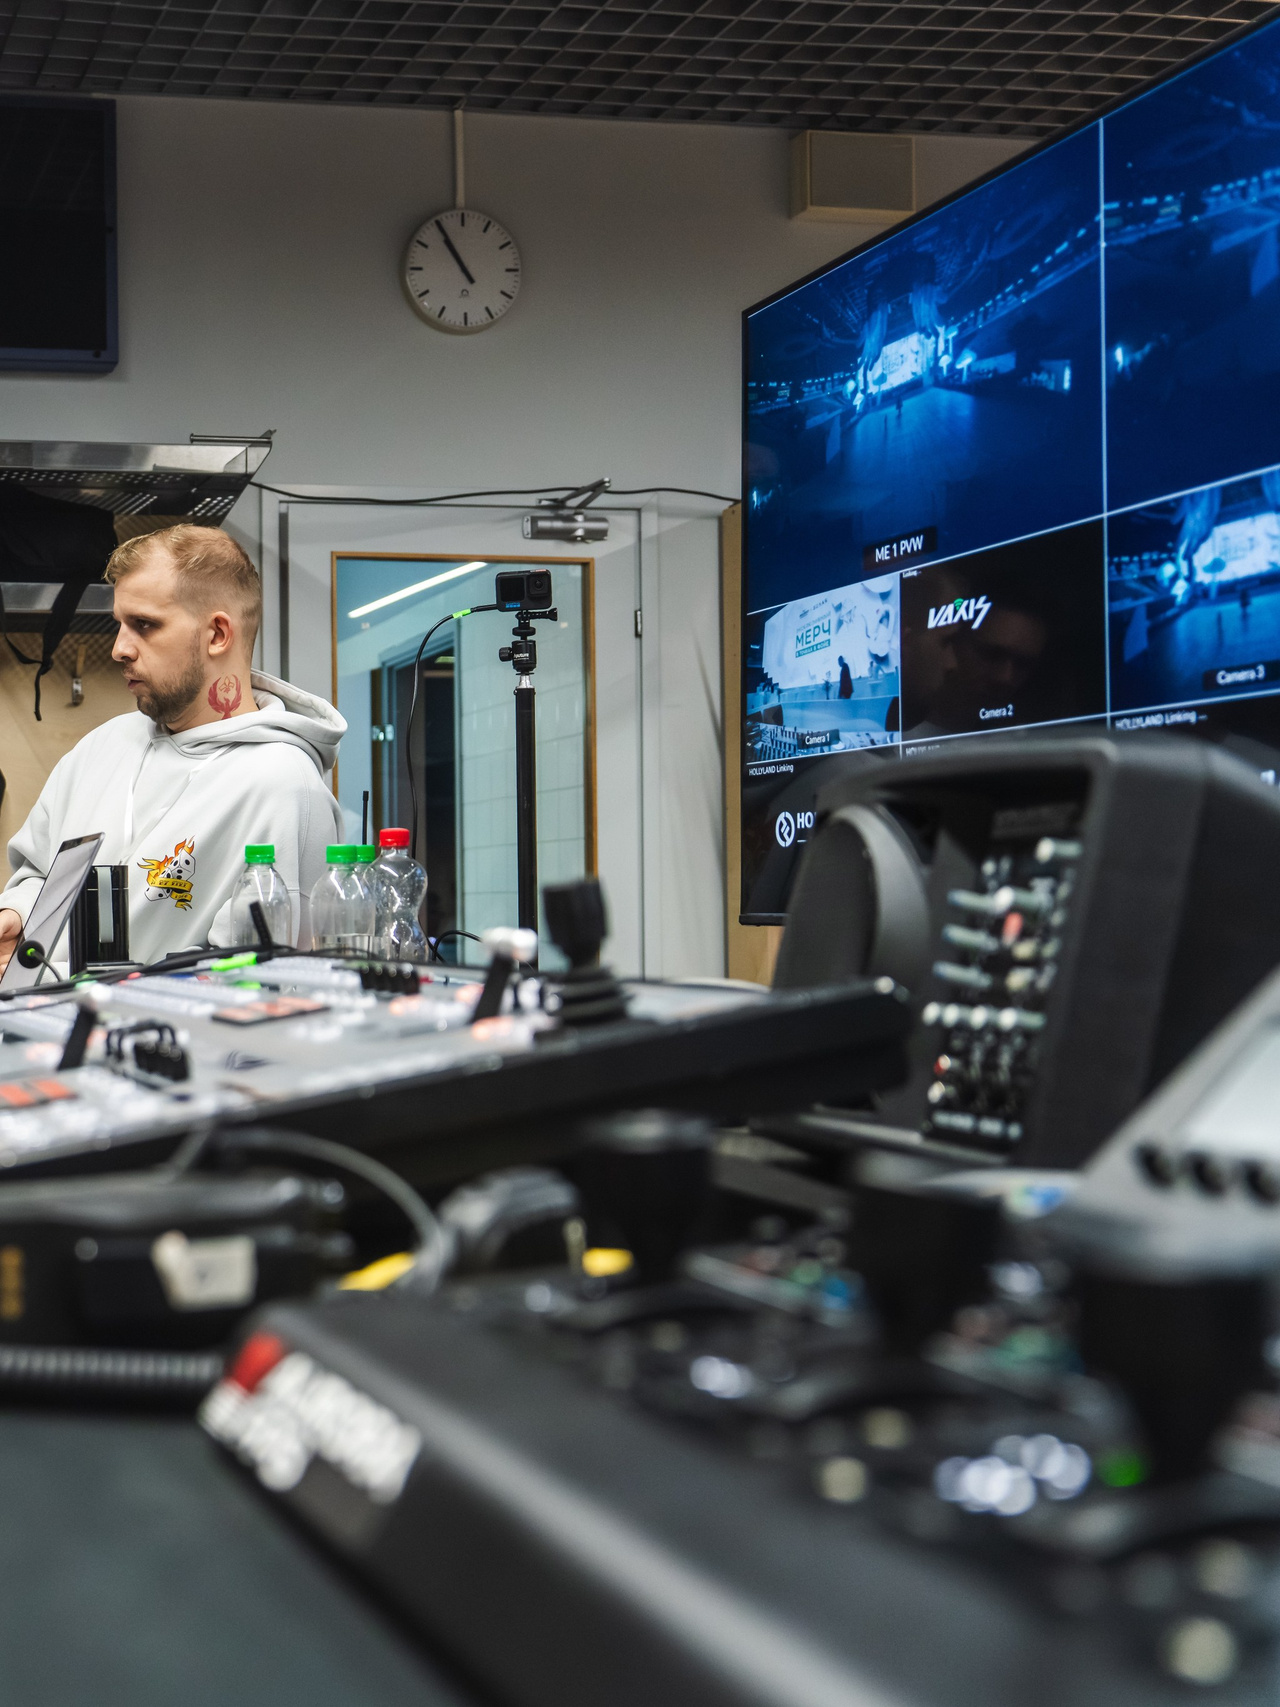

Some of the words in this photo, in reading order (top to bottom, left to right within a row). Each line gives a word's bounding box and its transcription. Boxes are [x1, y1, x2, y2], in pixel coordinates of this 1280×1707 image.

[875, 545, 891, 563] ME
[892, 543, 898, 557] 1
[900, 535, 924, 556] PVW
[927, 595, 992, 629] VAXIS
[796, 619, 831, 649] МЕРЧ
[1216, 669, 1256, 685] Camera
[1256, 664, 1265, 680] 3
[979, 707, 1007, 719] Camera
[1007, 704, 1014, 716] 2
[805, 735, 826, 745] Camera
[826, 732, 830, 742] 1
[749, 766, 776, 776] HOLLYLAND
[777, 763, 794, 773] Linking
[797, 812, 816, 829] HO
